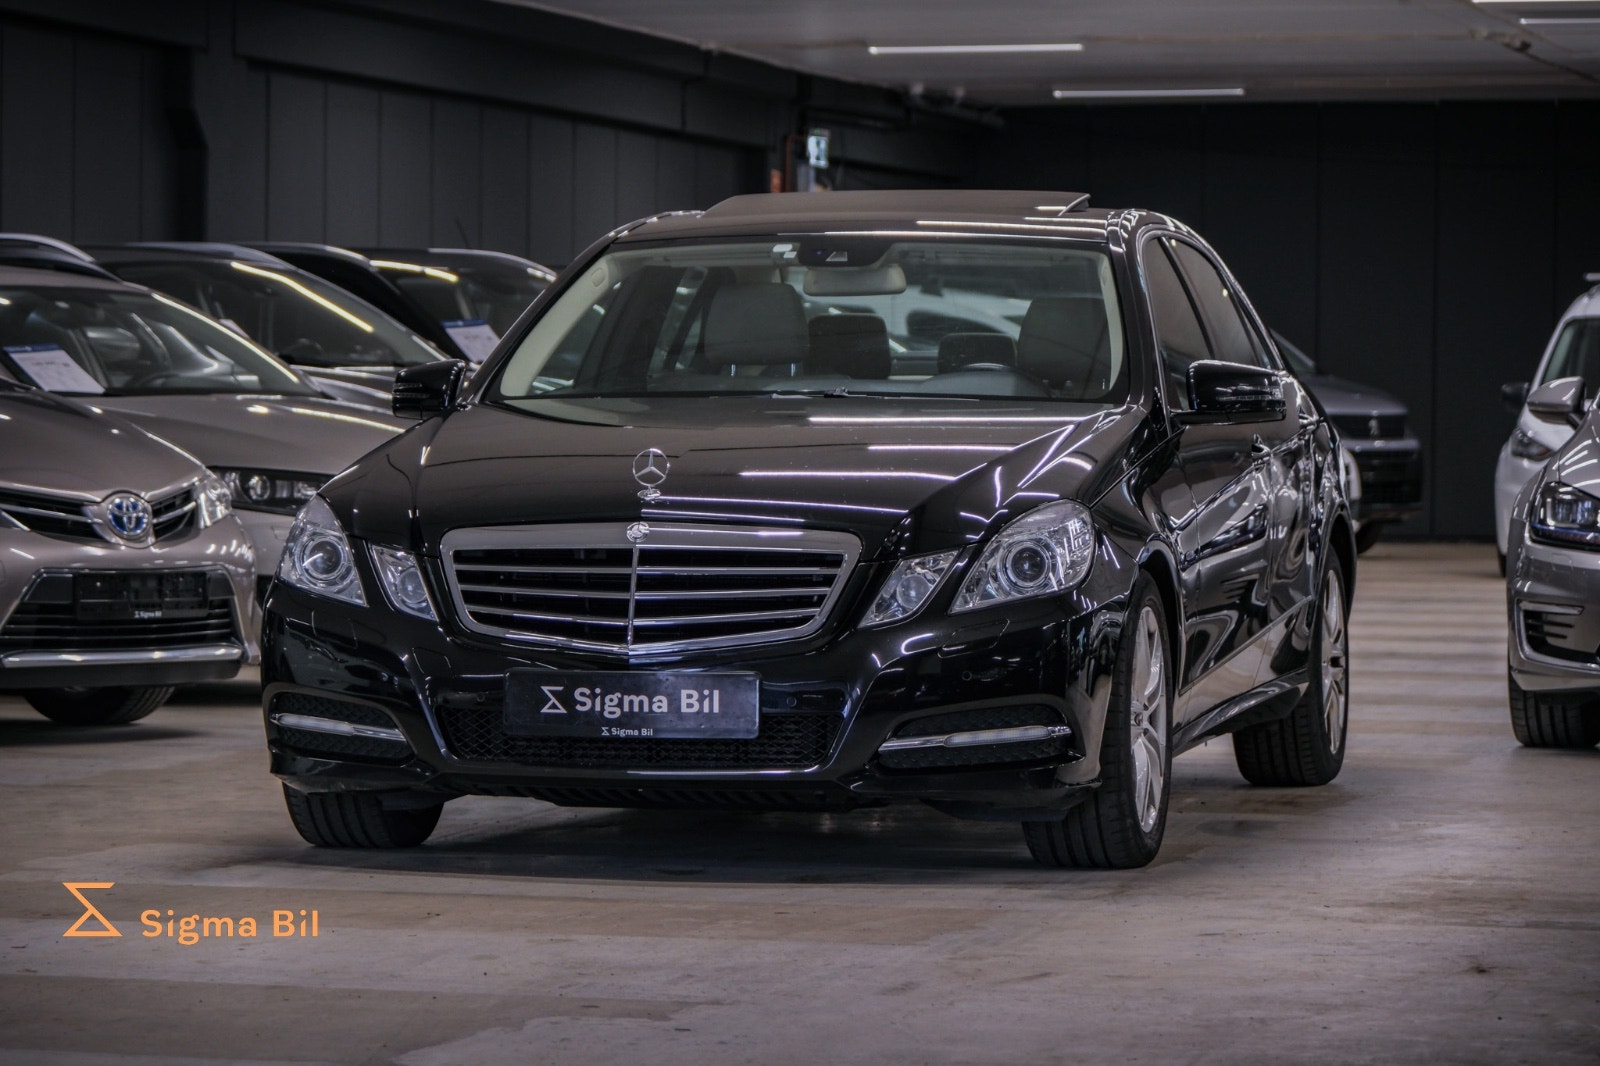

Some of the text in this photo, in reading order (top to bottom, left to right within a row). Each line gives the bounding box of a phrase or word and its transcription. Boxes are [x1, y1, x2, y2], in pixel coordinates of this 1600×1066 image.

[574, 686, 720, 719] Sigma Bil
[611, 727, 653, 737] Sigma Bil
